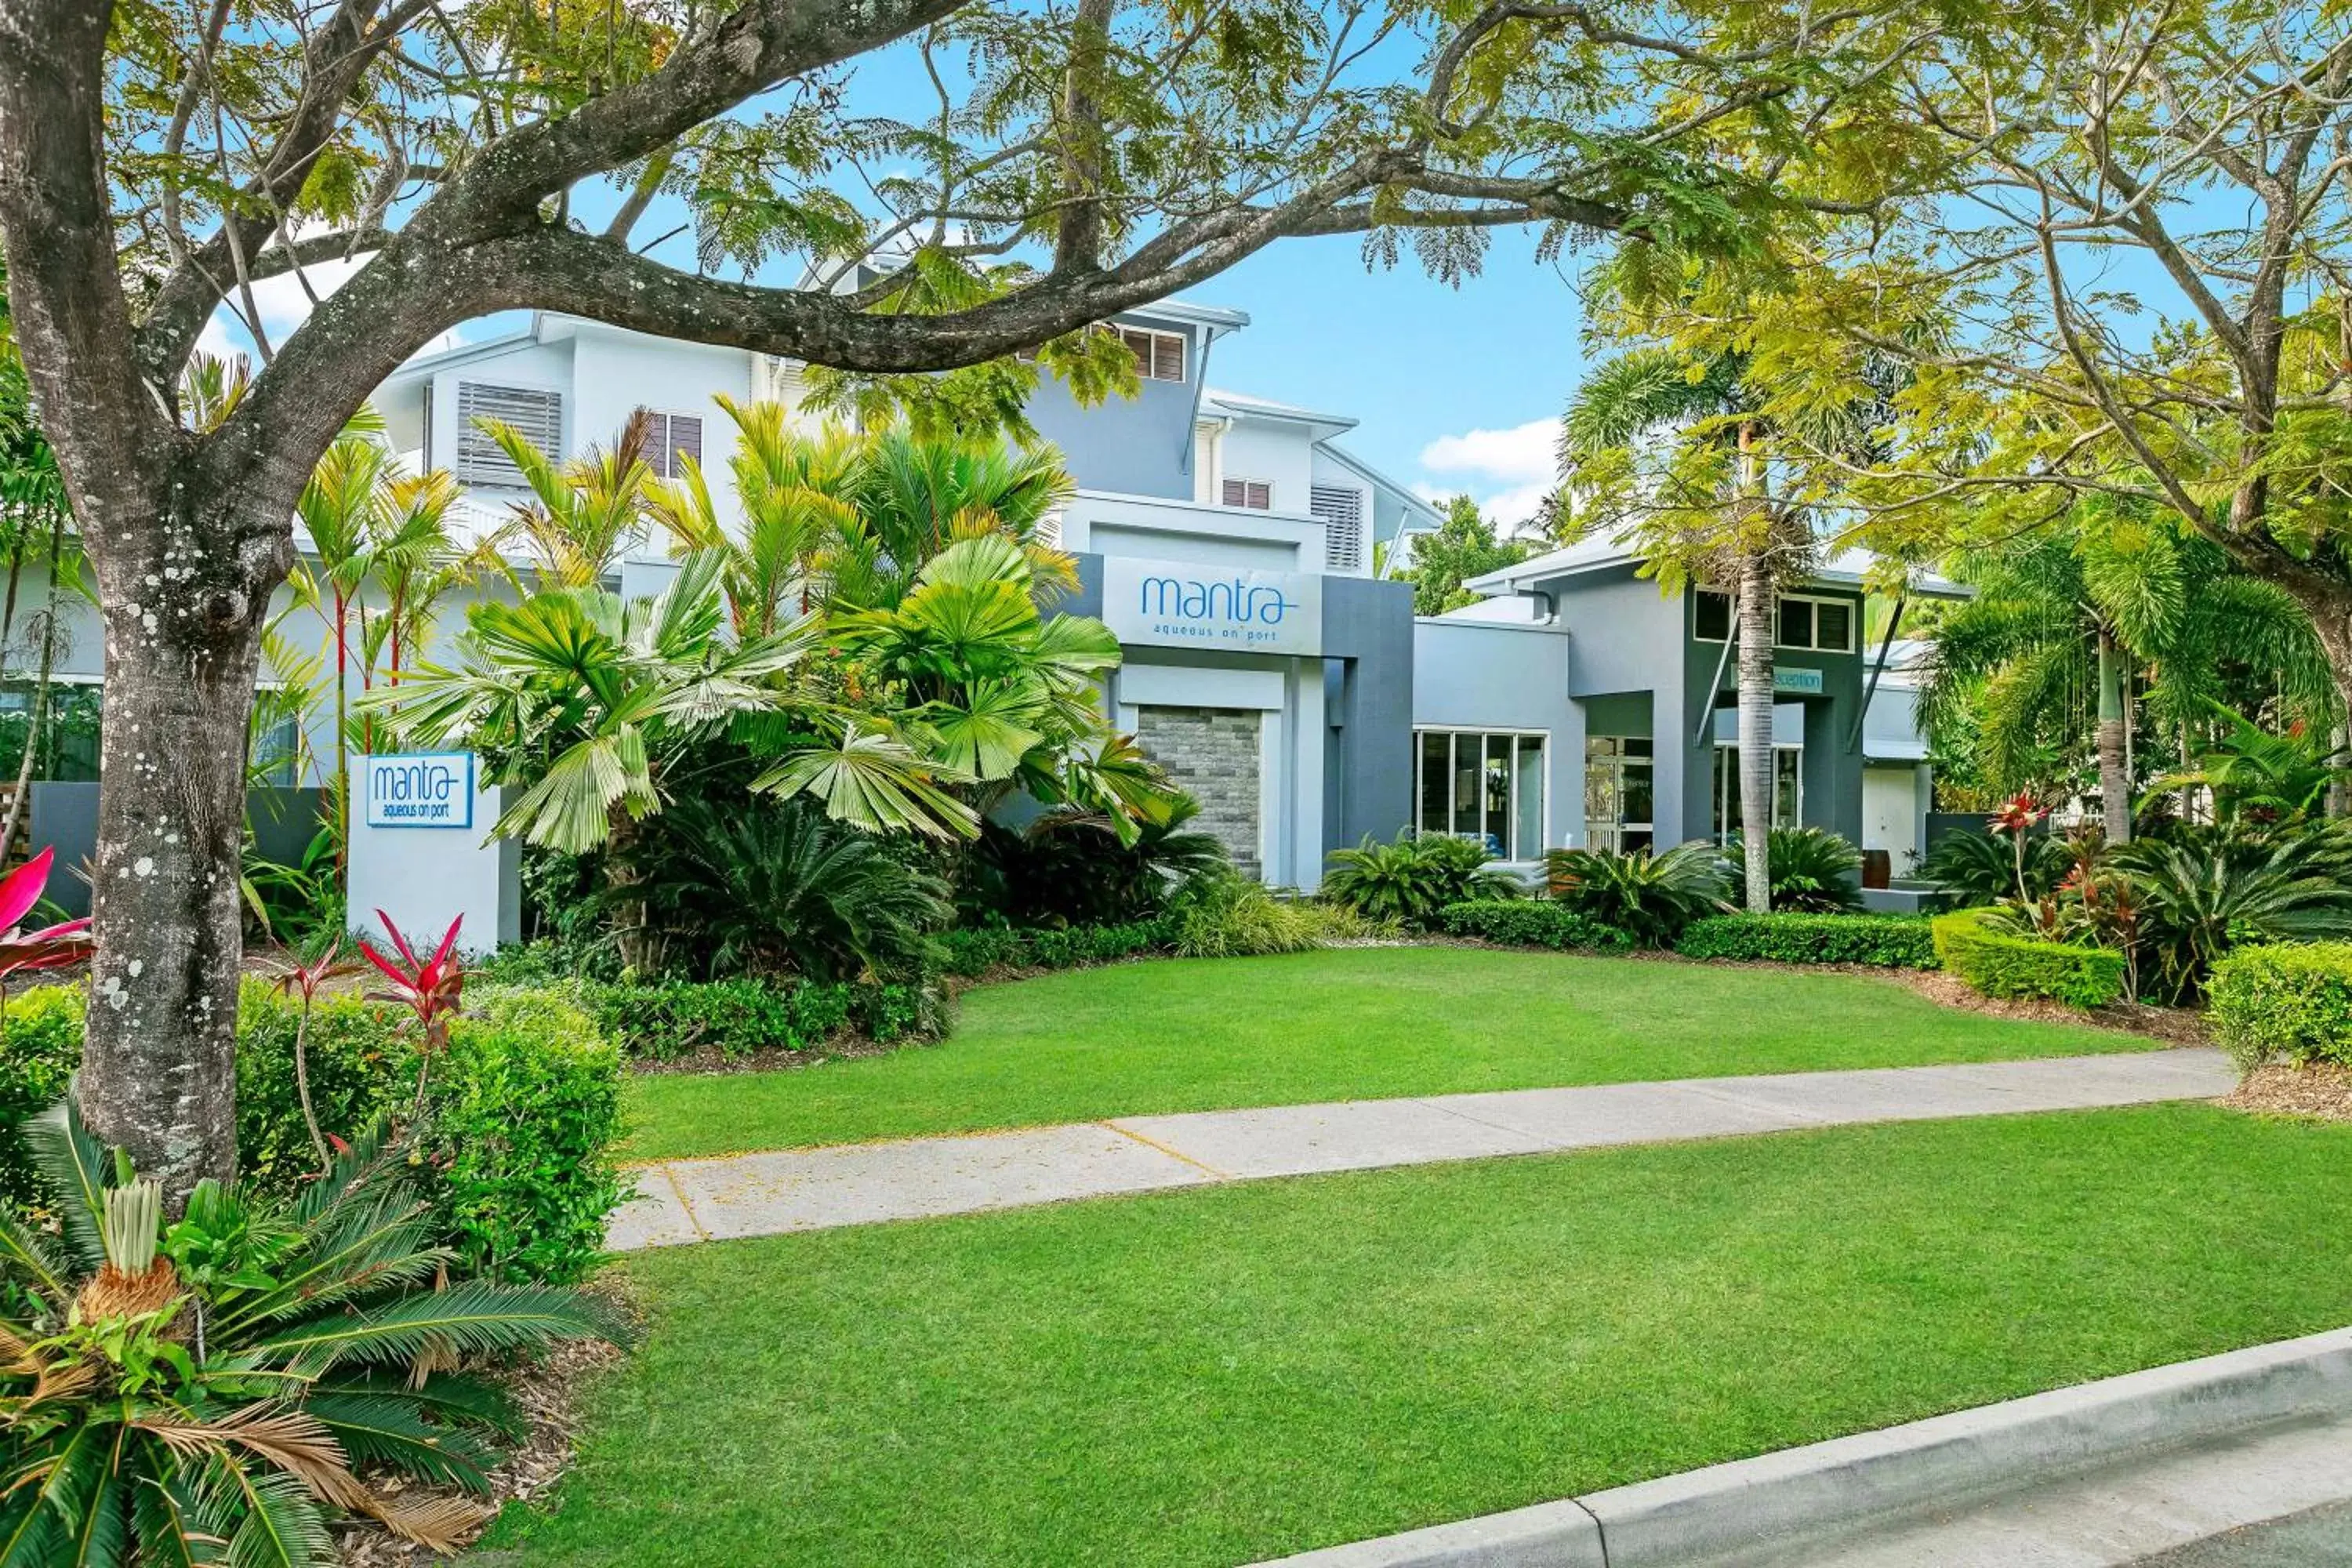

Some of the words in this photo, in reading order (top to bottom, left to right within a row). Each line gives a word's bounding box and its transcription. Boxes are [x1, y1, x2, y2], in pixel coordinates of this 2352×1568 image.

[1142, 577, 1299, 625] mantra
[1153, 625, 1214, 637] aqueous
[1222, 629, 1239, 639] on
[1247, 630, 1276, 641] port
[1774, 672, 1820, 688] eception
[375, 760, 459, 800] mantra
[383, 804, 416, 818] aqueous
[418, 804, 430, 817] on
[431, 803, 449, 819] port
